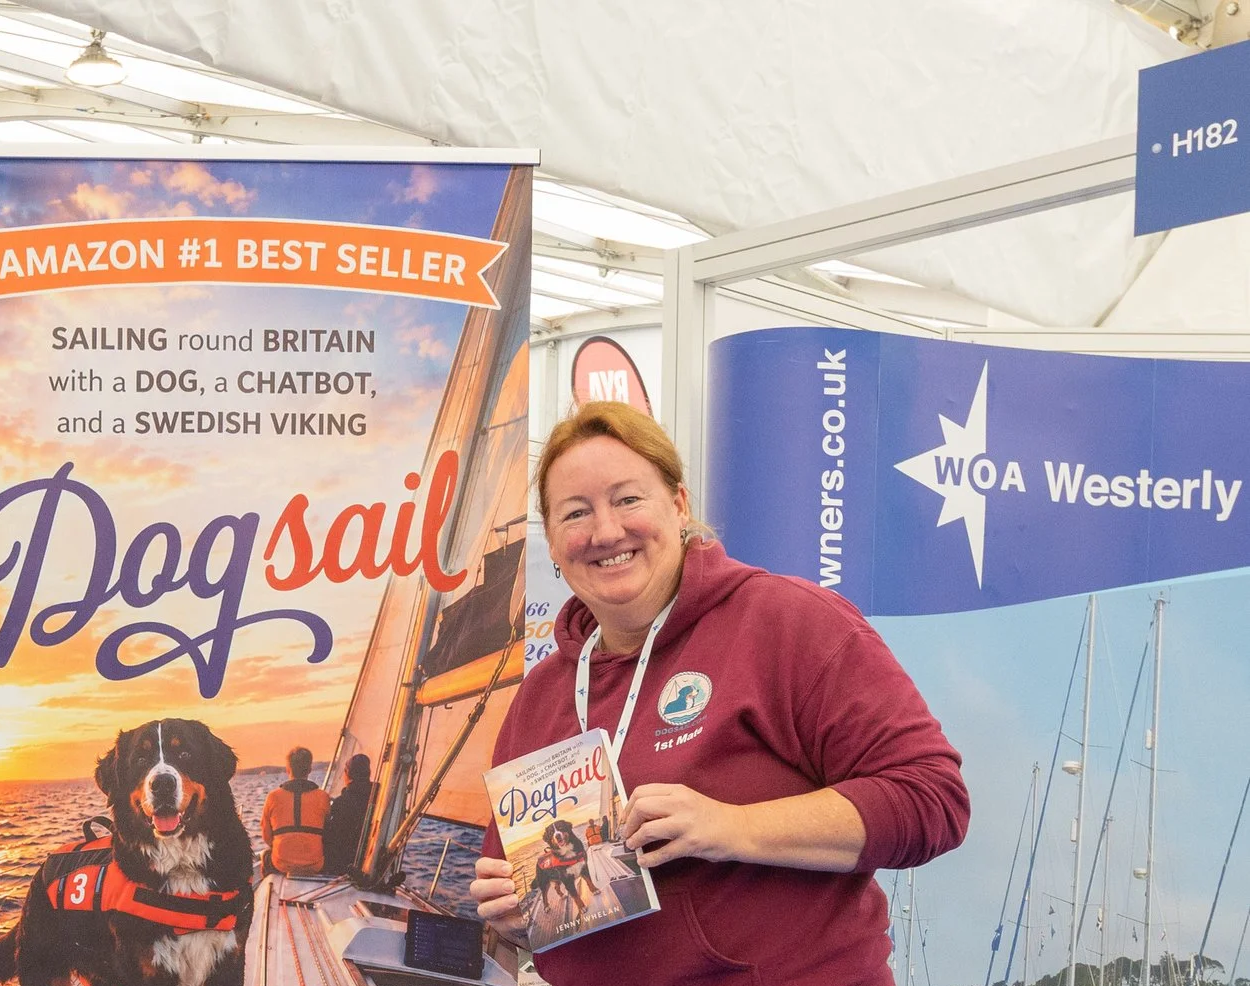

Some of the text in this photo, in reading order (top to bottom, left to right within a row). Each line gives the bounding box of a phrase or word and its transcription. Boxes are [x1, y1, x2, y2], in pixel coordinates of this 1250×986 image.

[1173, 119, 1238, 157] H182
[177, 238, 222, 269] #1
[237, 239, 327, 272] BEST
[336, 243, 467, 286] SELLER
[51, 326, 376, 354] SAILING round BRITAIN
[48, 369, 377, 400] with a DOG, a CHATBOT,
[57, 410, 367, 437] and a SWEDISH VIKING
[817, 347, 847, 592] wners.co.uk
[933, 453, 1026, 493] WOA
[1044, 461, 1243, 521] Westerly
[654, 739, 674, 752] 1st
[500, 746, 606, 827] Dogsail
[70, 873, 88, 904] 3
[555, 906, 620, 934] JENNY WHELAN
